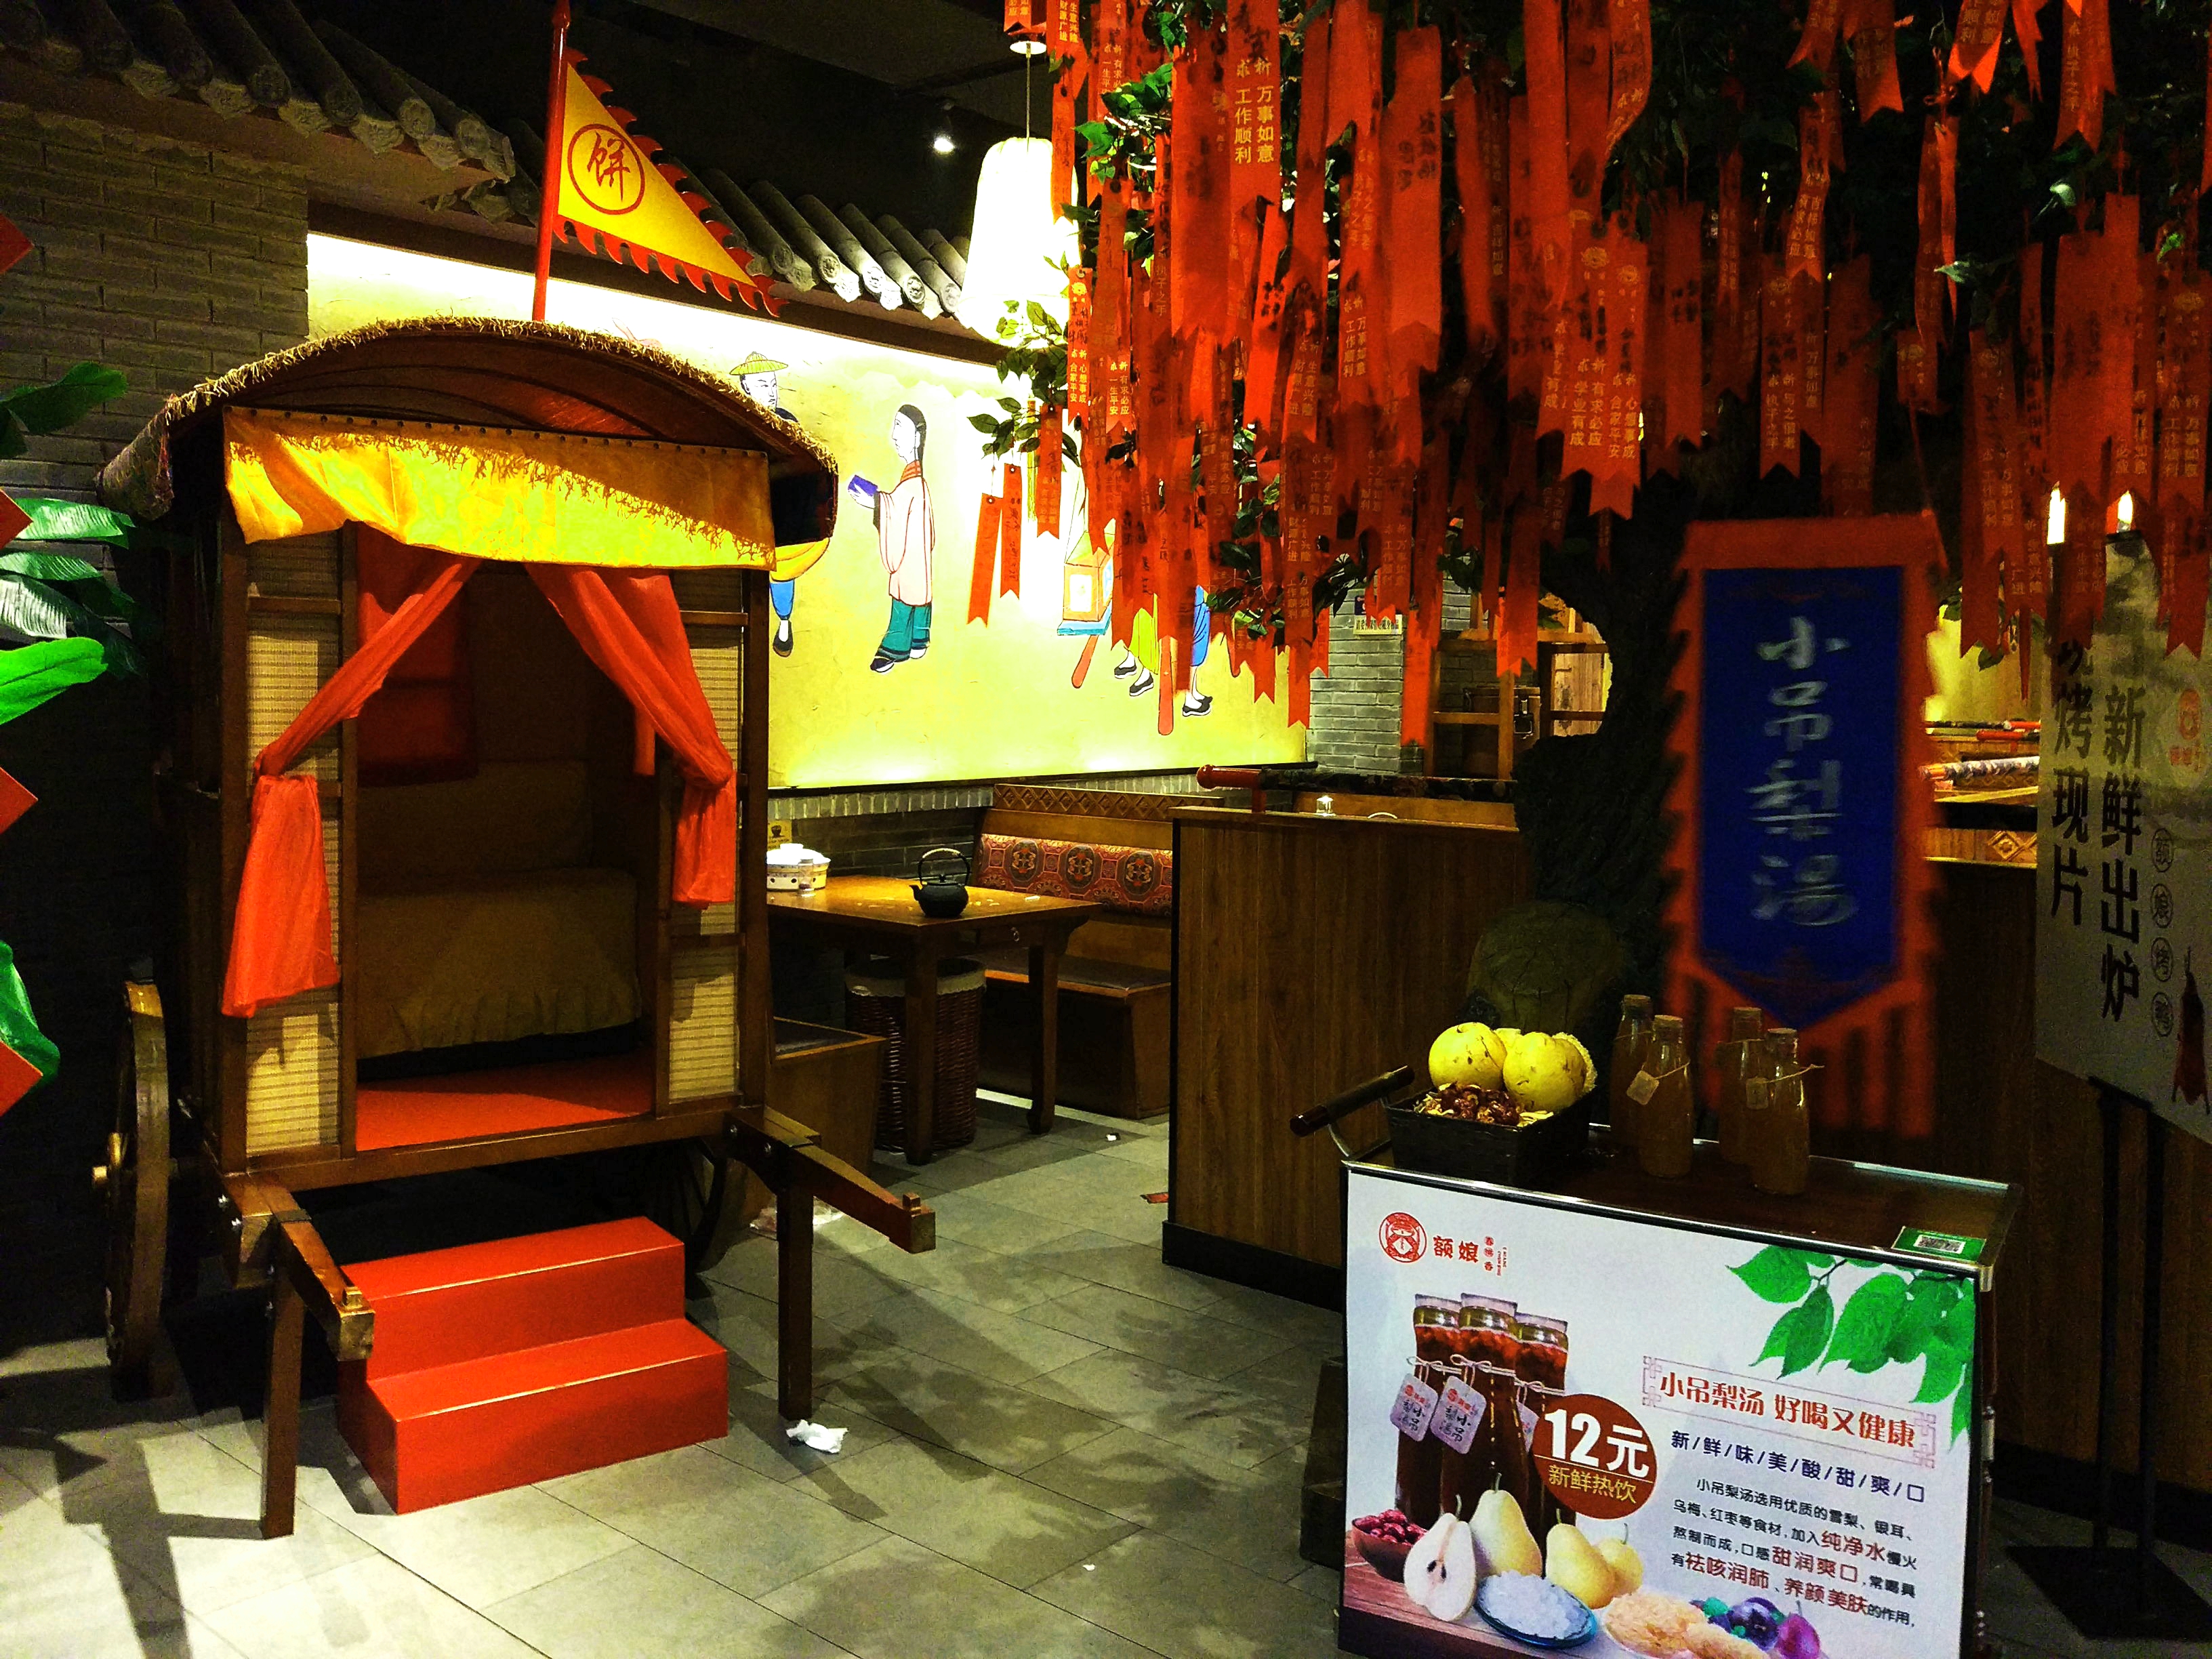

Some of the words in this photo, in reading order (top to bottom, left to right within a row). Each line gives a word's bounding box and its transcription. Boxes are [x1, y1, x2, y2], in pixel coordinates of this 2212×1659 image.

[1235, 61, 1251, 79] 求
[1254, 59, 1272, 77] 祈
[1234, 88, 1252, 165] 工作顺利
[1256, 85, 1275, 163] 万事如意
[1343, 320, 1355, 378] 工作顺利
[1356, 316, 1367, 375] 万事如意
[1069, 362, 1078, 403] 合家平安
[1079, 363, 1088, 404] 心想事成
[1109, 378, 1119, 415] 一生平安
[1120, 375, 1130, 415] 有求必应
[1286, 579, 1298, 619] 工作顺利
[1299, 576, 1312, 619] 万事如意
[2101, 683, 2146, 1022] 新鲜出炉
[1660, 1372, 1764, 1416] 小吊梨汤
[1774, 1393, 1916, 1448] 好喝又健康
[1544, 1409, 1650, 1478] 12元
[1549, 1465, 1637, 1504] 新鲜热饮
